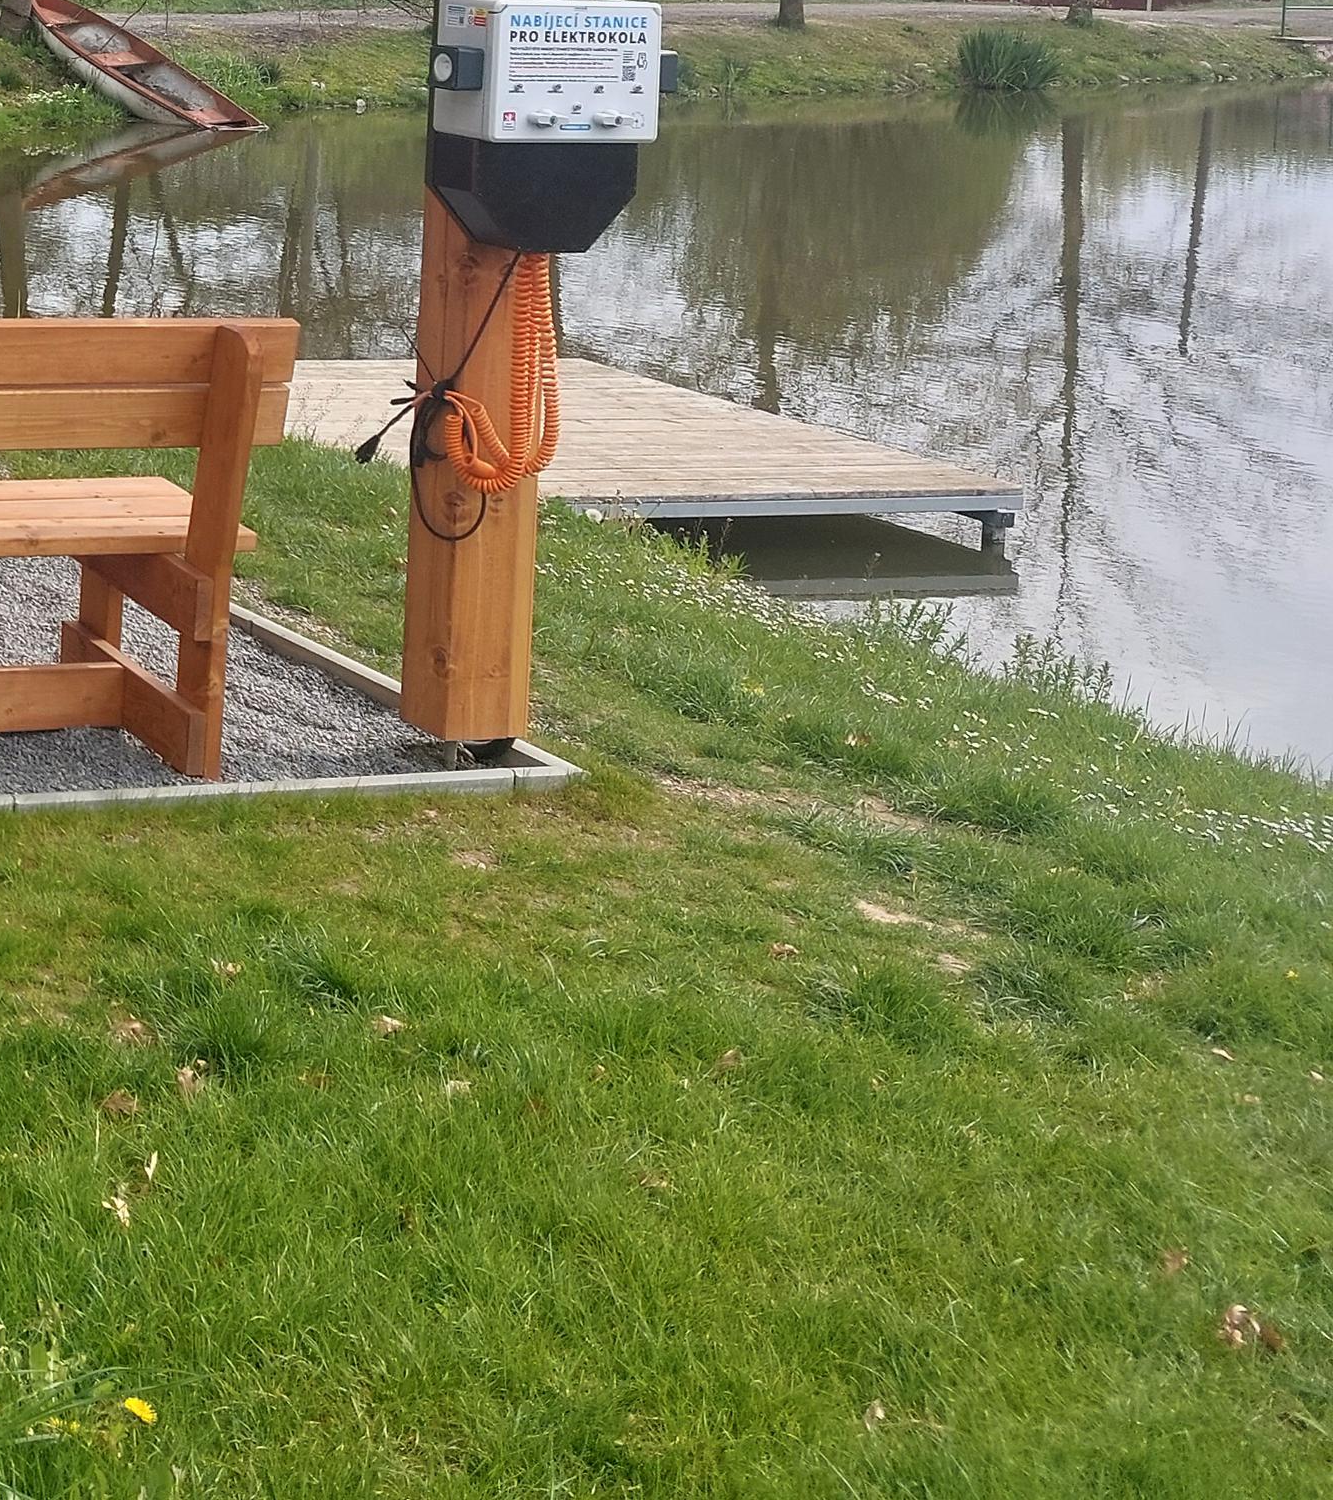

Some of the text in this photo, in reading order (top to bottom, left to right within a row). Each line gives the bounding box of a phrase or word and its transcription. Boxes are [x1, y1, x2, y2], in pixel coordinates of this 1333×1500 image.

[510, 12, 648, 30] NABÍJECÍ STANICE
[509, 30, 647, 44] PRO ELEKTROKOLA
